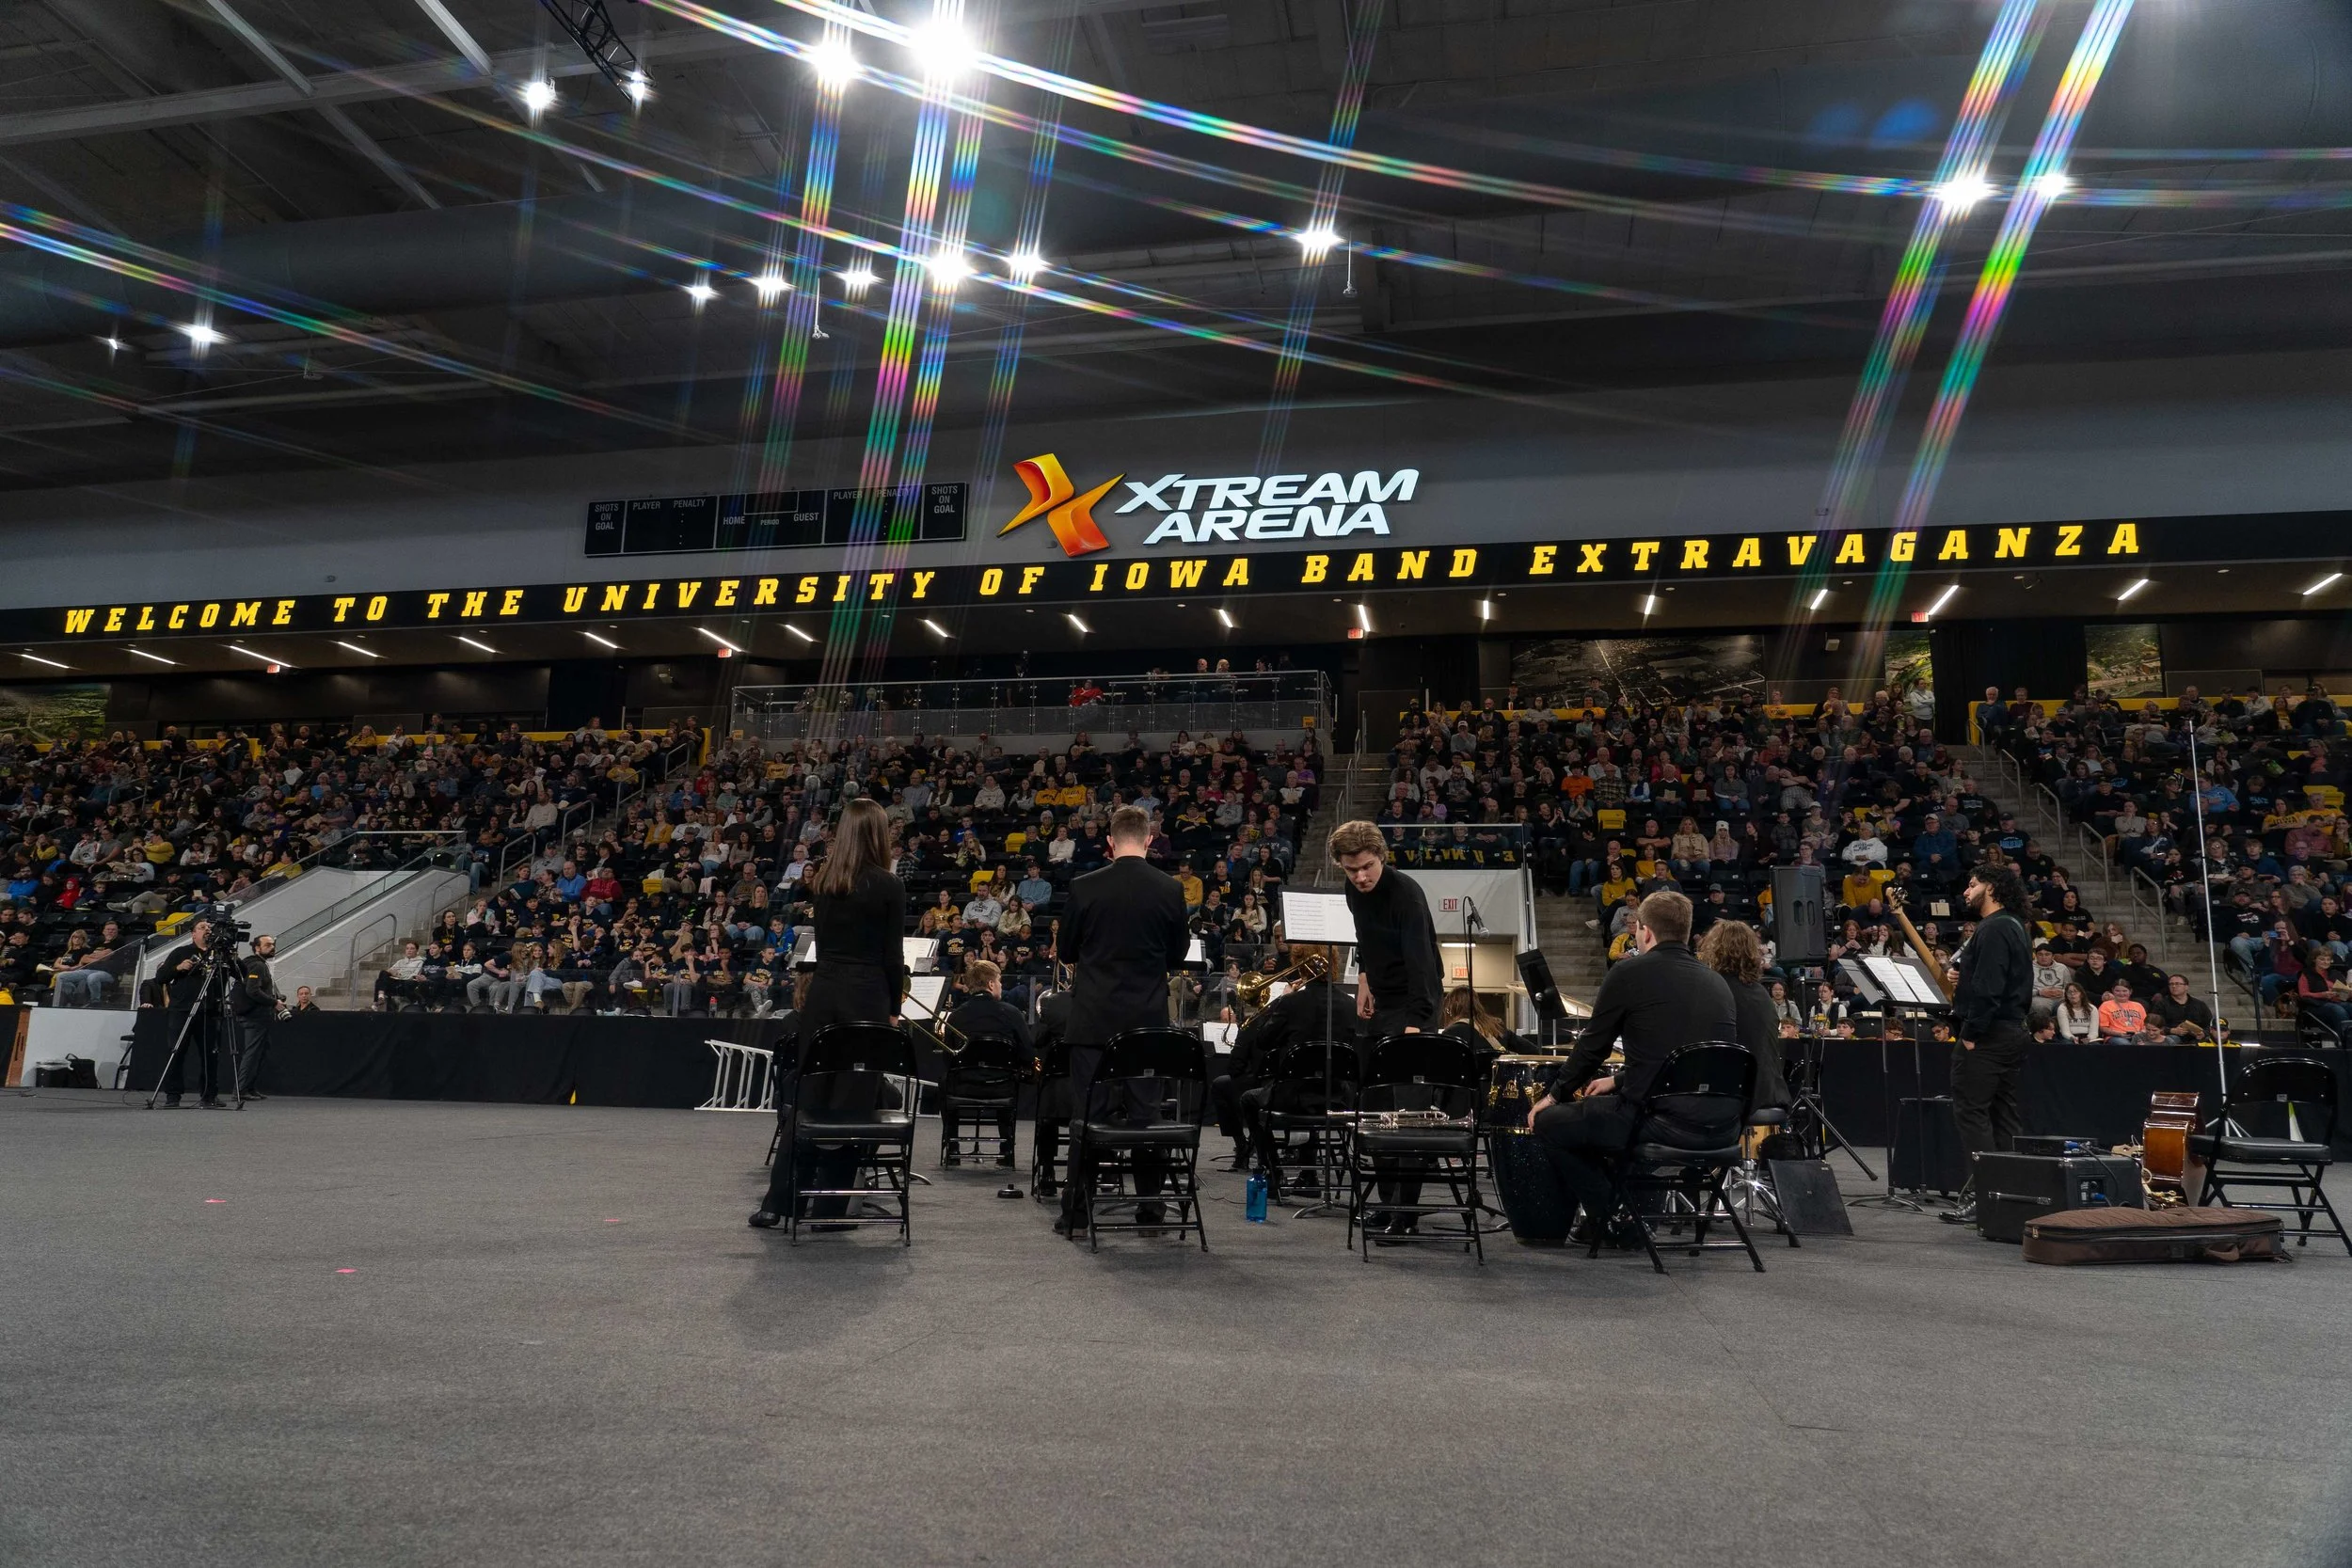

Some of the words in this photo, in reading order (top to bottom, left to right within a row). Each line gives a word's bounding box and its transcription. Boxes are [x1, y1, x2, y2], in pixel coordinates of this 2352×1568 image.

[834, 490, 863, 499] PLAYER
[876, 487, 911, 498] PENALTY
[931, 485, 958, 495] SHOTS
[1115, 468, 1420, 515] XTREAM
[939, 495, 951, 503] ON
[595, 503, 619, 513] SHOTS
[633, 501, 661, 511] PLAYER
[674, 499, 706, 508] PENALTY
[934, 504, 955, 514] GOAL
[600, 513, 612, 521] ON
[723, 516, 745, 525] HOME
[793, 513, 818, 522] GUEST
[596, 521, 614, 531] GOAL
[1142, 503, 1391, 545] ARENA
[65, 600, 295, 634] WELCOME
[334, 596, 388, 623] TO
[428, 590, 524, 619] THE
[564, 571, 935, 613] UNIVERSITY
[979, 566, 1045, 595] OF
[1090, 559, 1249, 592] IOWA
[1301, 548, 1478, 583] BAND
[1530, 523, 2139, 575] EXTRAVAGANZA
[1443, 898, 1457, 911] EXIT
